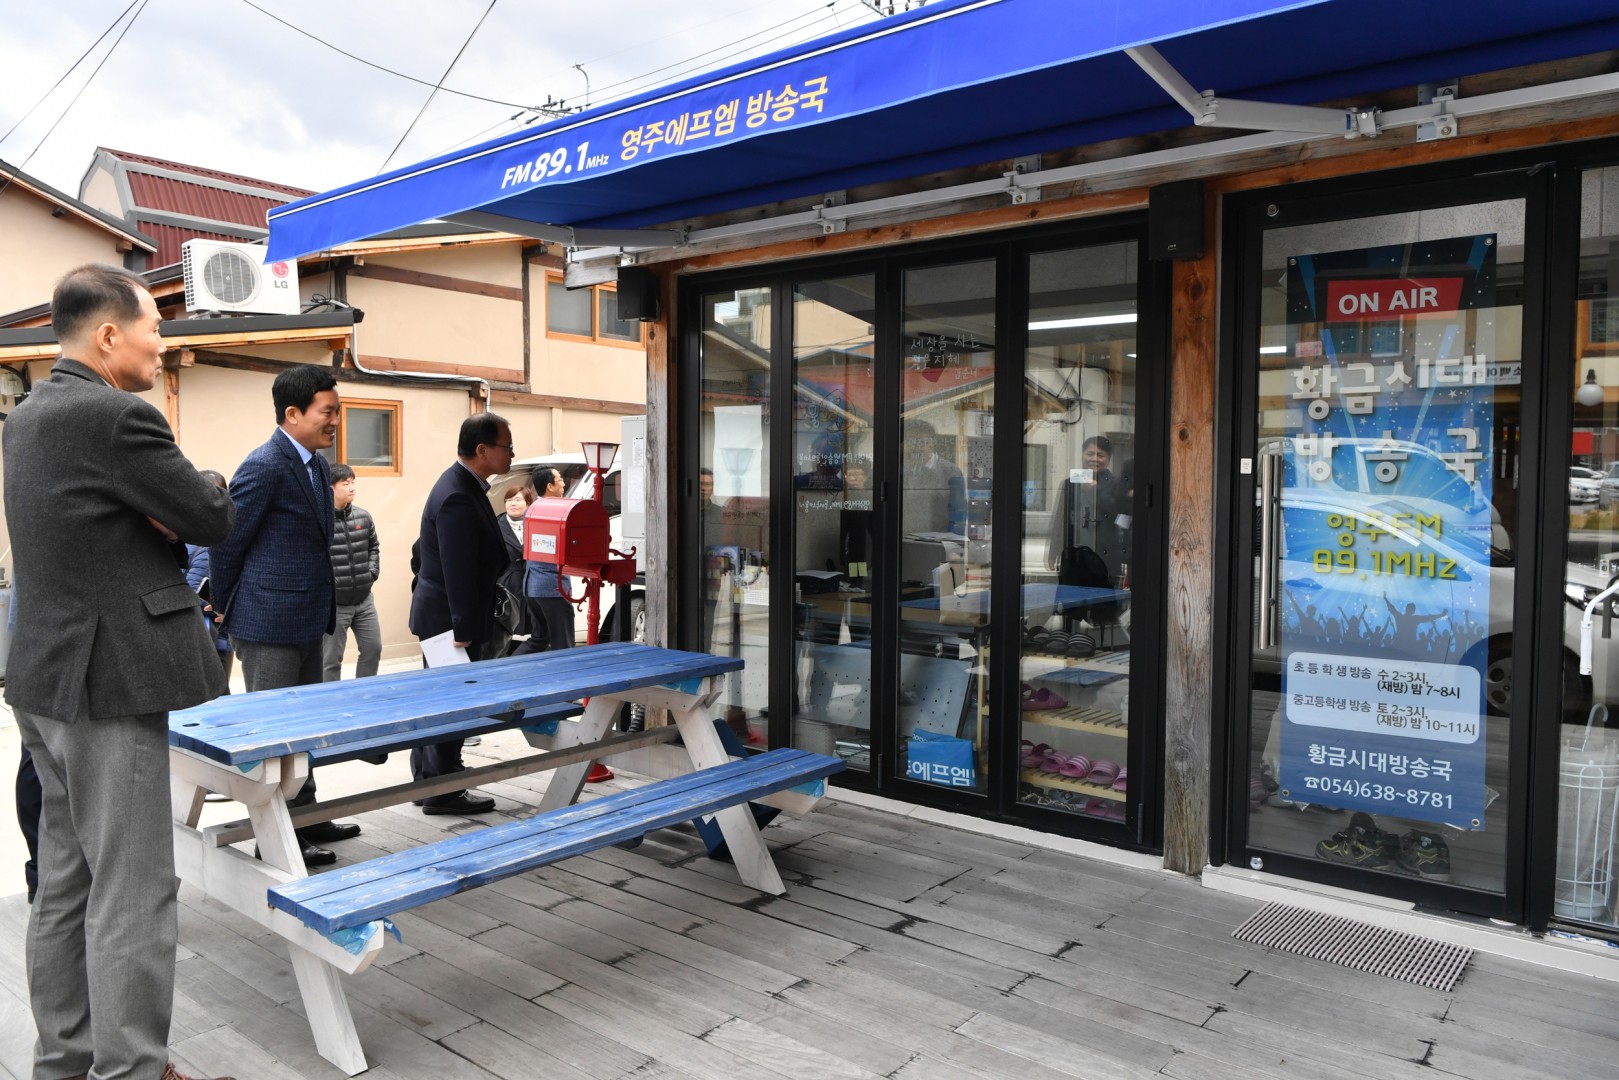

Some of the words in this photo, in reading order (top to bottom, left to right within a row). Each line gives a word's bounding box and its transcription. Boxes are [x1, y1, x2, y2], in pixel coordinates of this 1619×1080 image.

[620, 98, 739, 161] 영주에프엠
[746, 76, 829, 128] 방송국
[274, 280, 288, 289] LG
[1338, 291, 1379, 315] ON
[1388, 287, 1438, 311] AIR
[911, 335, 948, 353] 세상을
[954, 333, 981, 348] 사는
[1292, 354, 1487, 420] 황금시대
[1327, 511, 1441, 547] 영주FM
[1313, 549, 1457, 580] 89.1MHz
[1349, 666, 1372, 680] 방송
[1378, 669, 1389, 681] 수
[1377, 679, 1408, 695] (재방)
[1411, 683, 1423, 696] 밤
[1425, 684, 1460, 699] 7~8시
[1293, 693, 1347, 711] 중고등학생
[1349, 699, 1372, 713] 방송
[1376, 702, 1389, 714] 토
[1376, 713, 1408, 729] (재방)
[1410, 717, 1422, 730] 밤
[1425, 719, 1476, 736] 10~11시
[906, 760, 970, 787] 에프엠
[1308, 744, 1453, 782] 황금시대방송국
